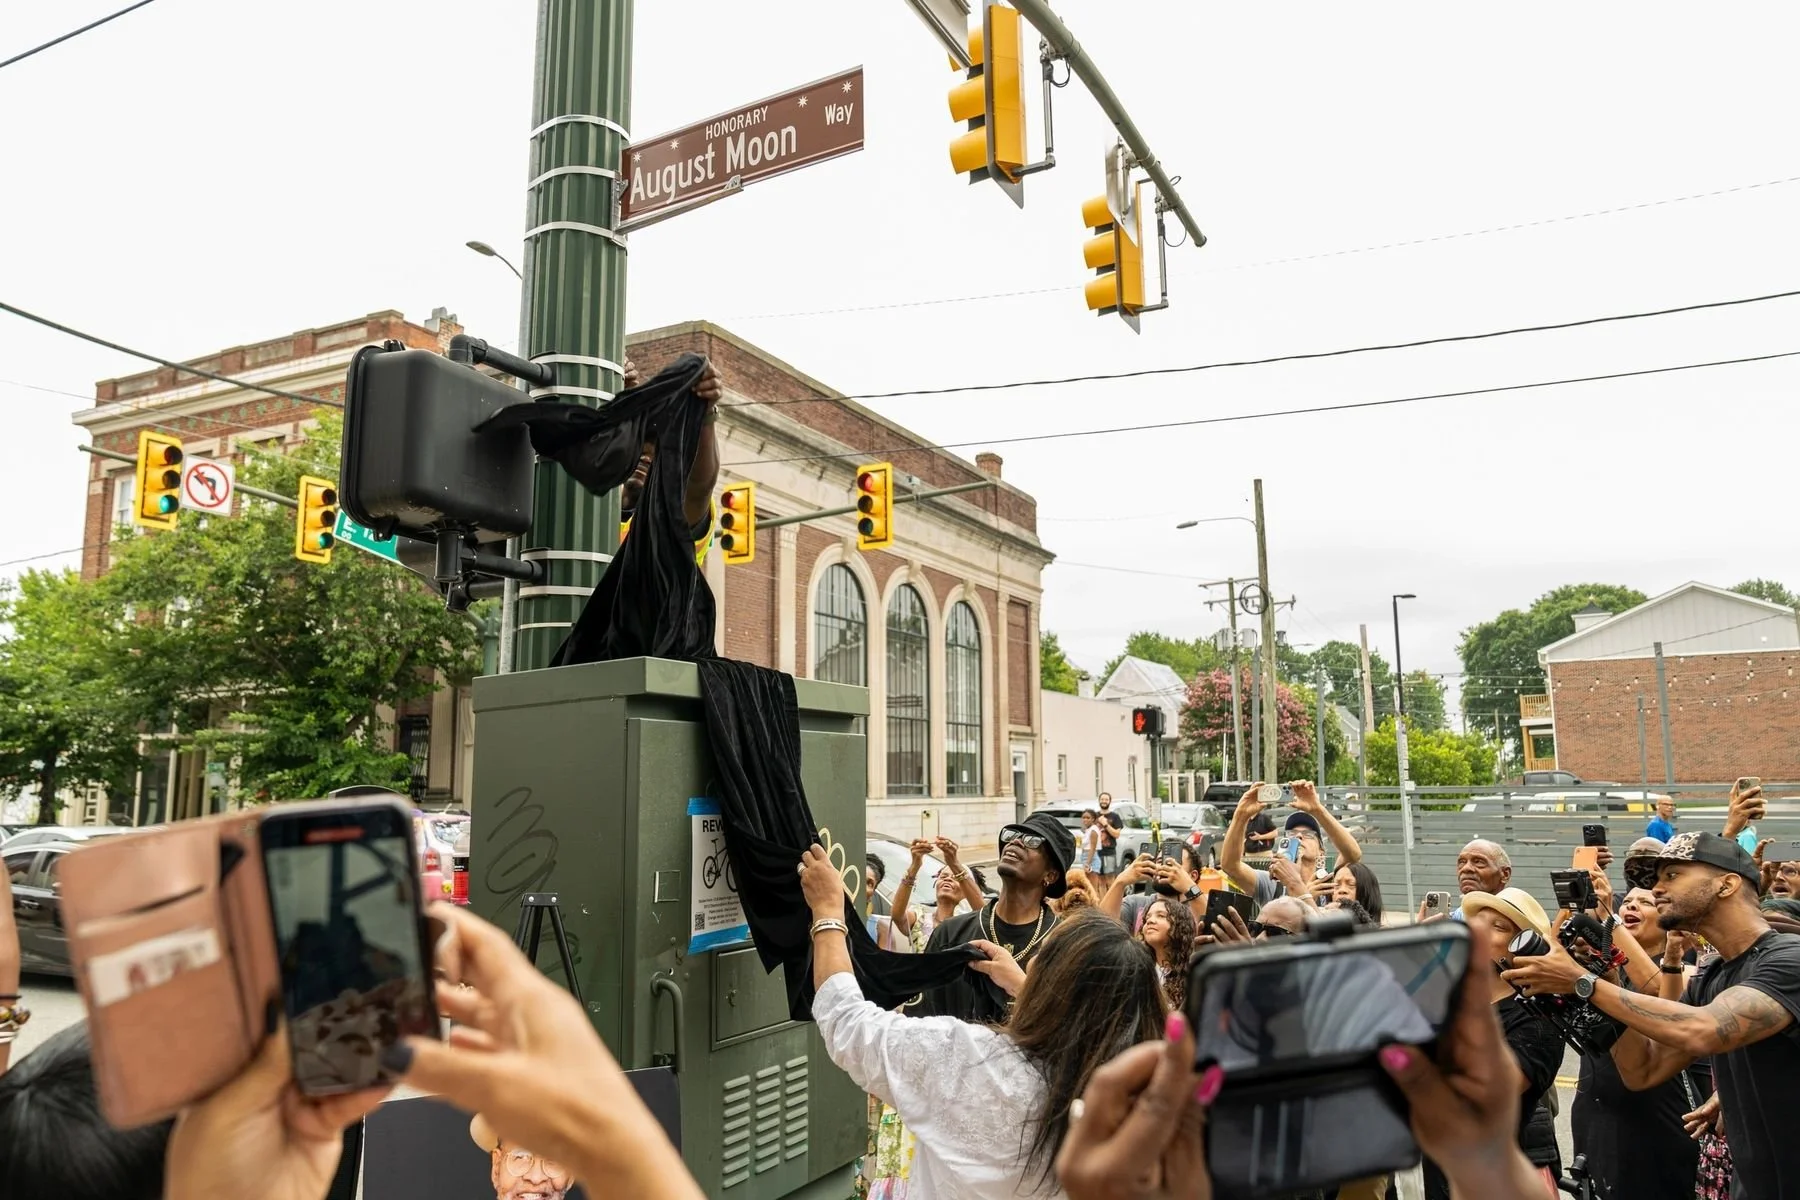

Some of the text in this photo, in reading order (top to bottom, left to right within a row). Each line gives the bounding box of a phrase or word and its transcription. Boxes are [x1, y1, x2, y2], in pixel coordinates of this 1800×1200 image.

[629, 103, 854, 205] August Moon Way
[705, 106, 769, 141] HONORARY
